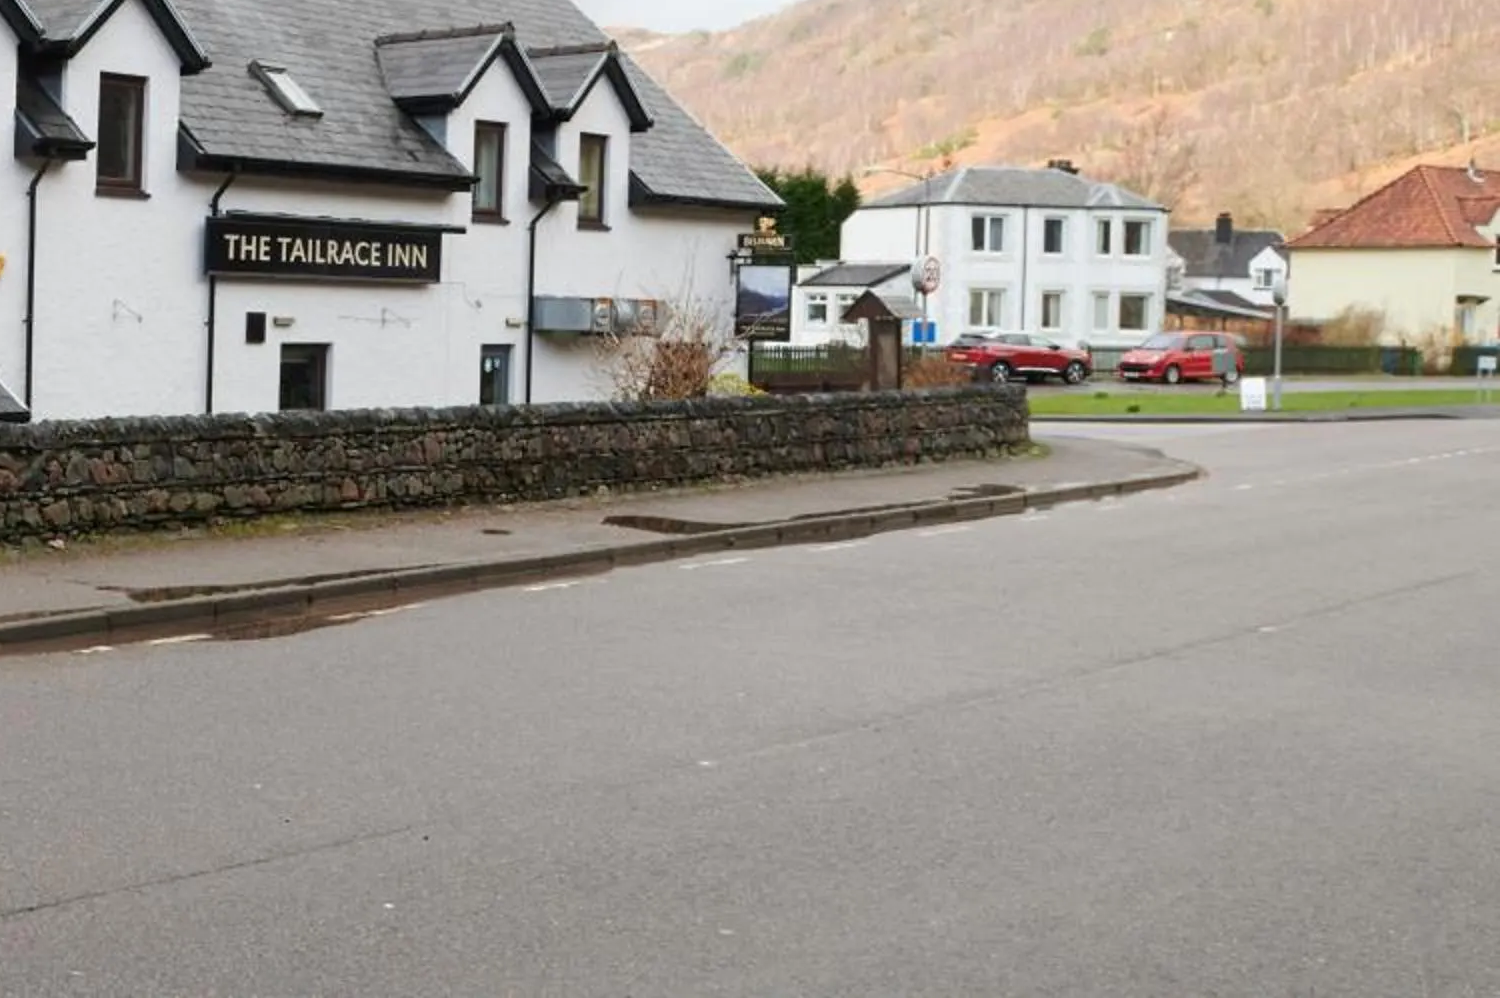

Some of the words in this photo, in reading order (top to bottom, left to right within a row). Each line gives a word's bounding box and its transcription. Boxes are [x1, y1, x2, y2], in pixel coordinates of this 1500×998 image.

[224, 234, 272, 262] THE
[277, 237, 381, 267] TAILRACE
[387, 243, 428, 268] INN
